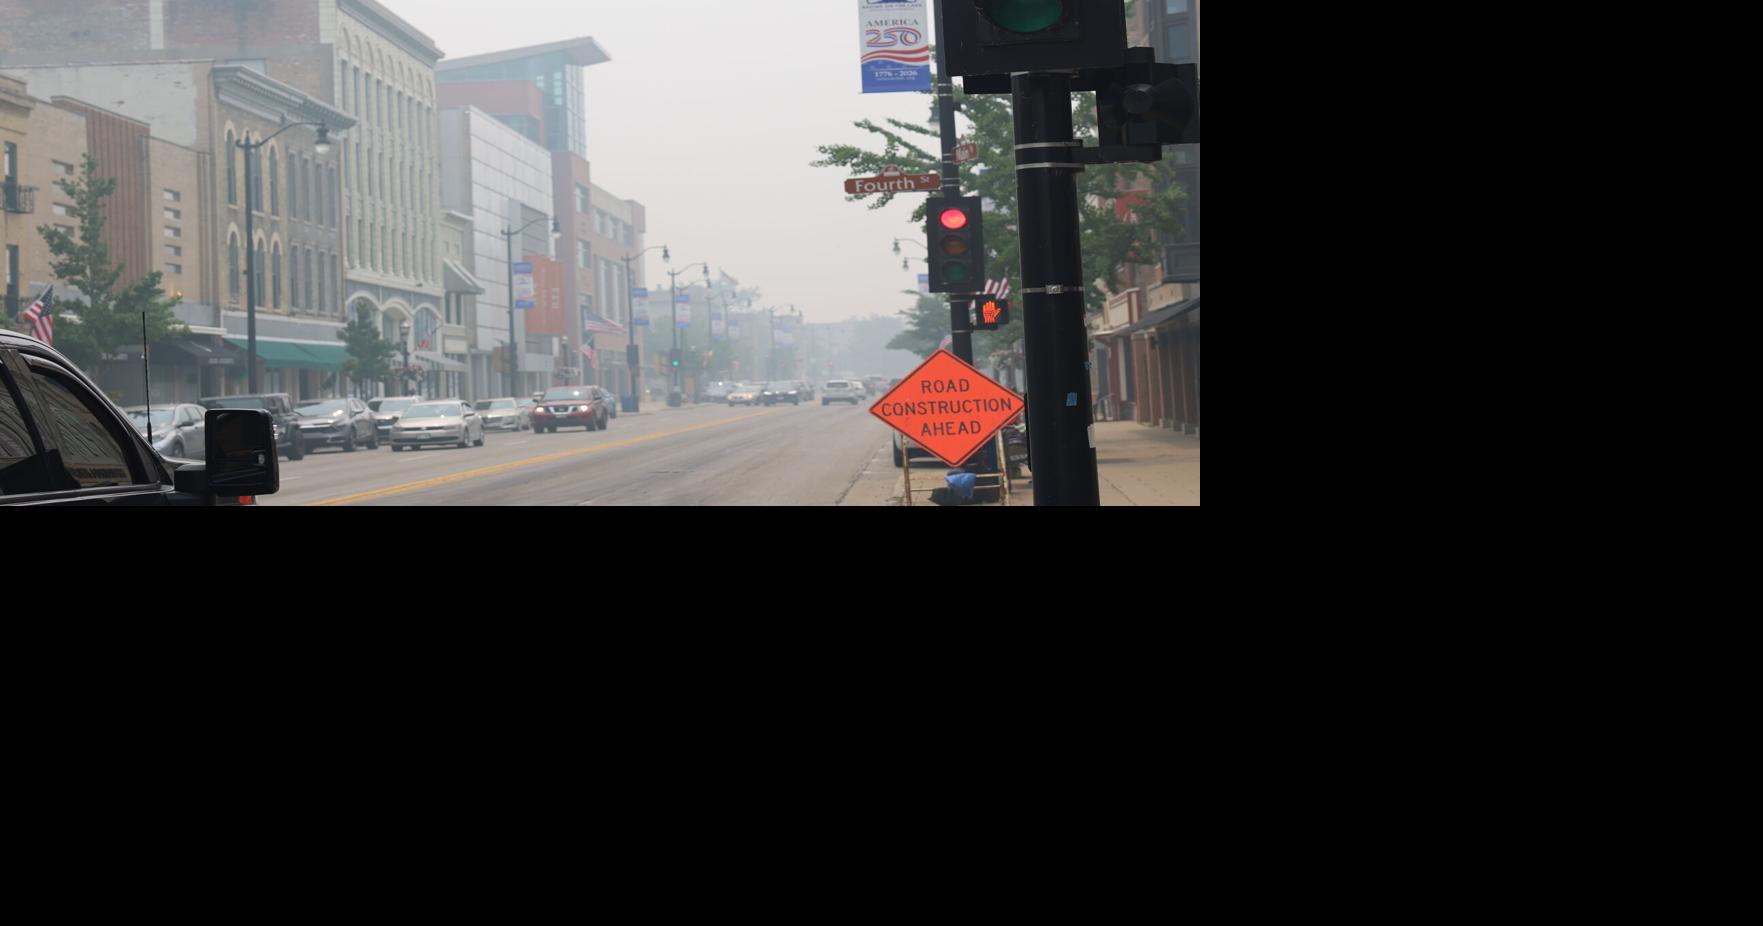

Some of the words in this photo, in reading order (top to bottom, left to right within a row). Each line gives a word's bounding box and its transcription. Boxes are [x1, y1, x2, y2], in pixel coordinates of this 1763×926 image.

[866, 19, 919, 27] AMERICA
[865, 26, 922, 47] 250
[855, 177, 915, 192] Fourth
[920, 175, 930, 183] St
[921, 378, 970, 394] ROAD
[881, 397, 1012, 417] CONSTRUCTION
[921, 420, 981, 437] AHEAD
